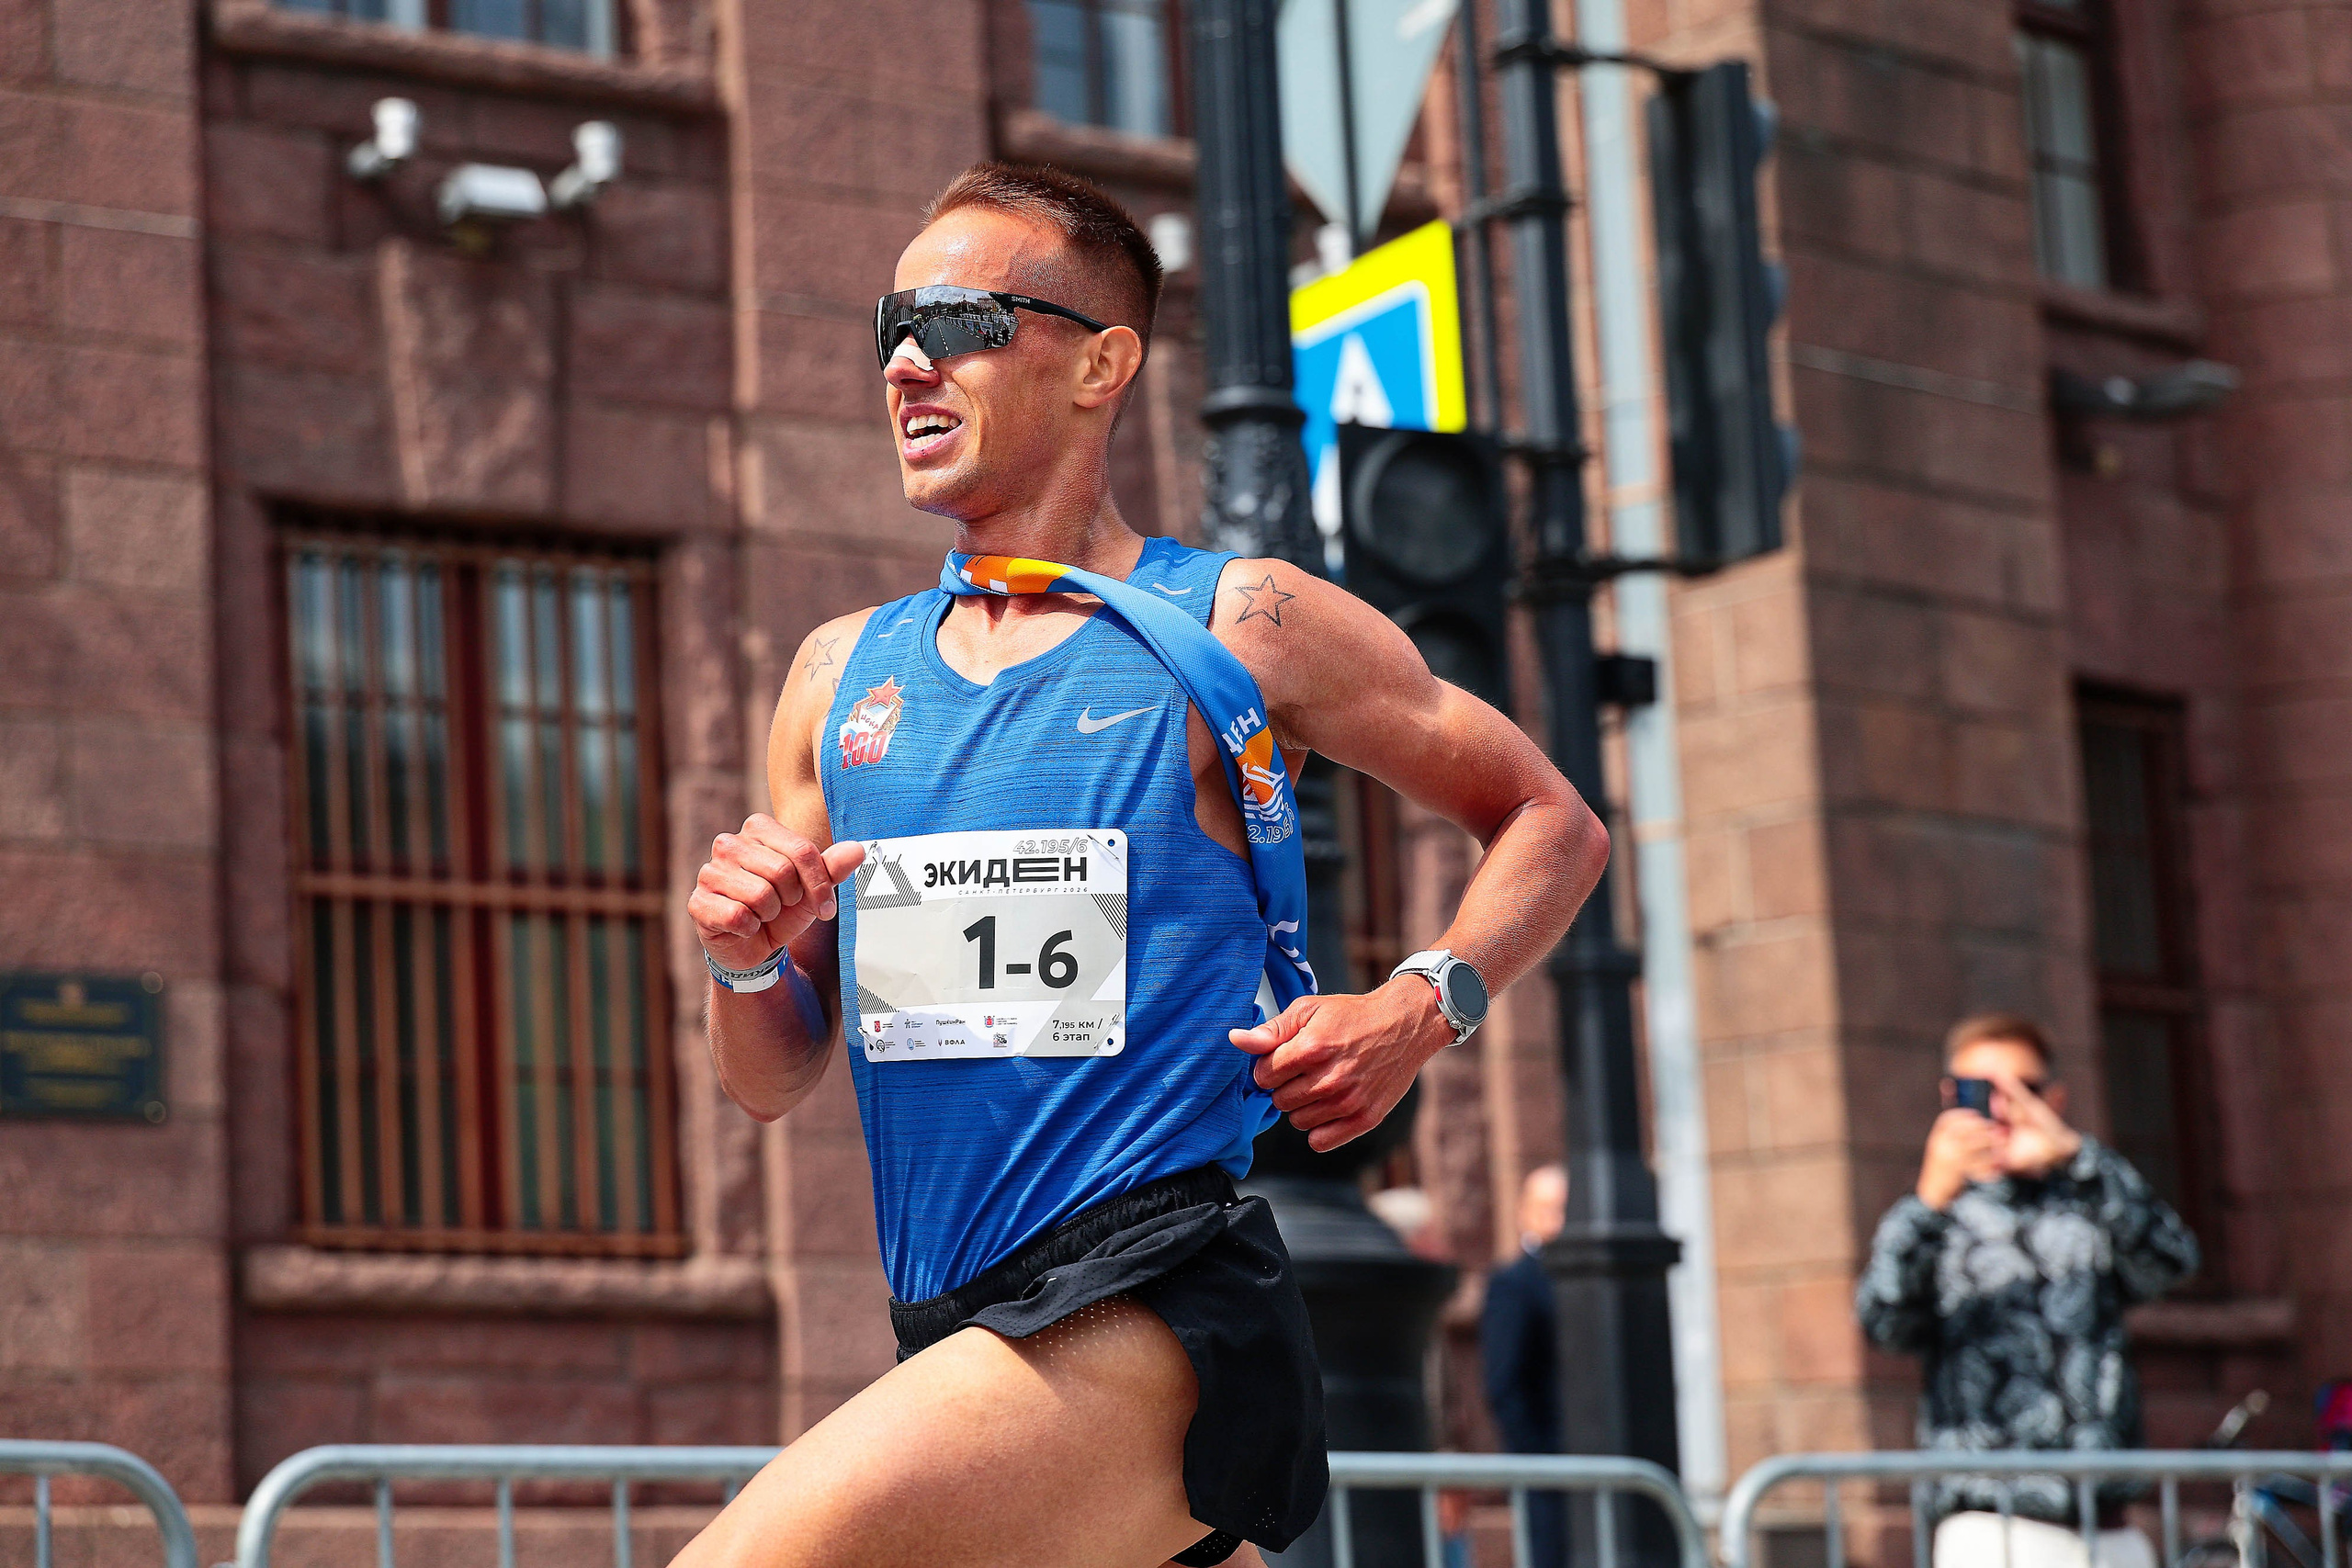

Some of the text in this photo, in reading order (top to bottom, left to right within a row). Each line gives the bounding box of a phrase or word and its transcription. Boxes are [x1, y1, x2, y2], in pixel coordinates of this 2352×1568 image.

[1012, 296, 1031, 304] SMITH
[840, 731, 888, 769] 100
[1012, 837, 1089, 855] 42.195/6
[924, 857, 1088, 888] ЭКИДЕН
[963, 916, 1079, 988] 1-6
[1052, 1020, 1075, 1030] 7,195
[1052, 1032, 1091, 1042] 6 этап
